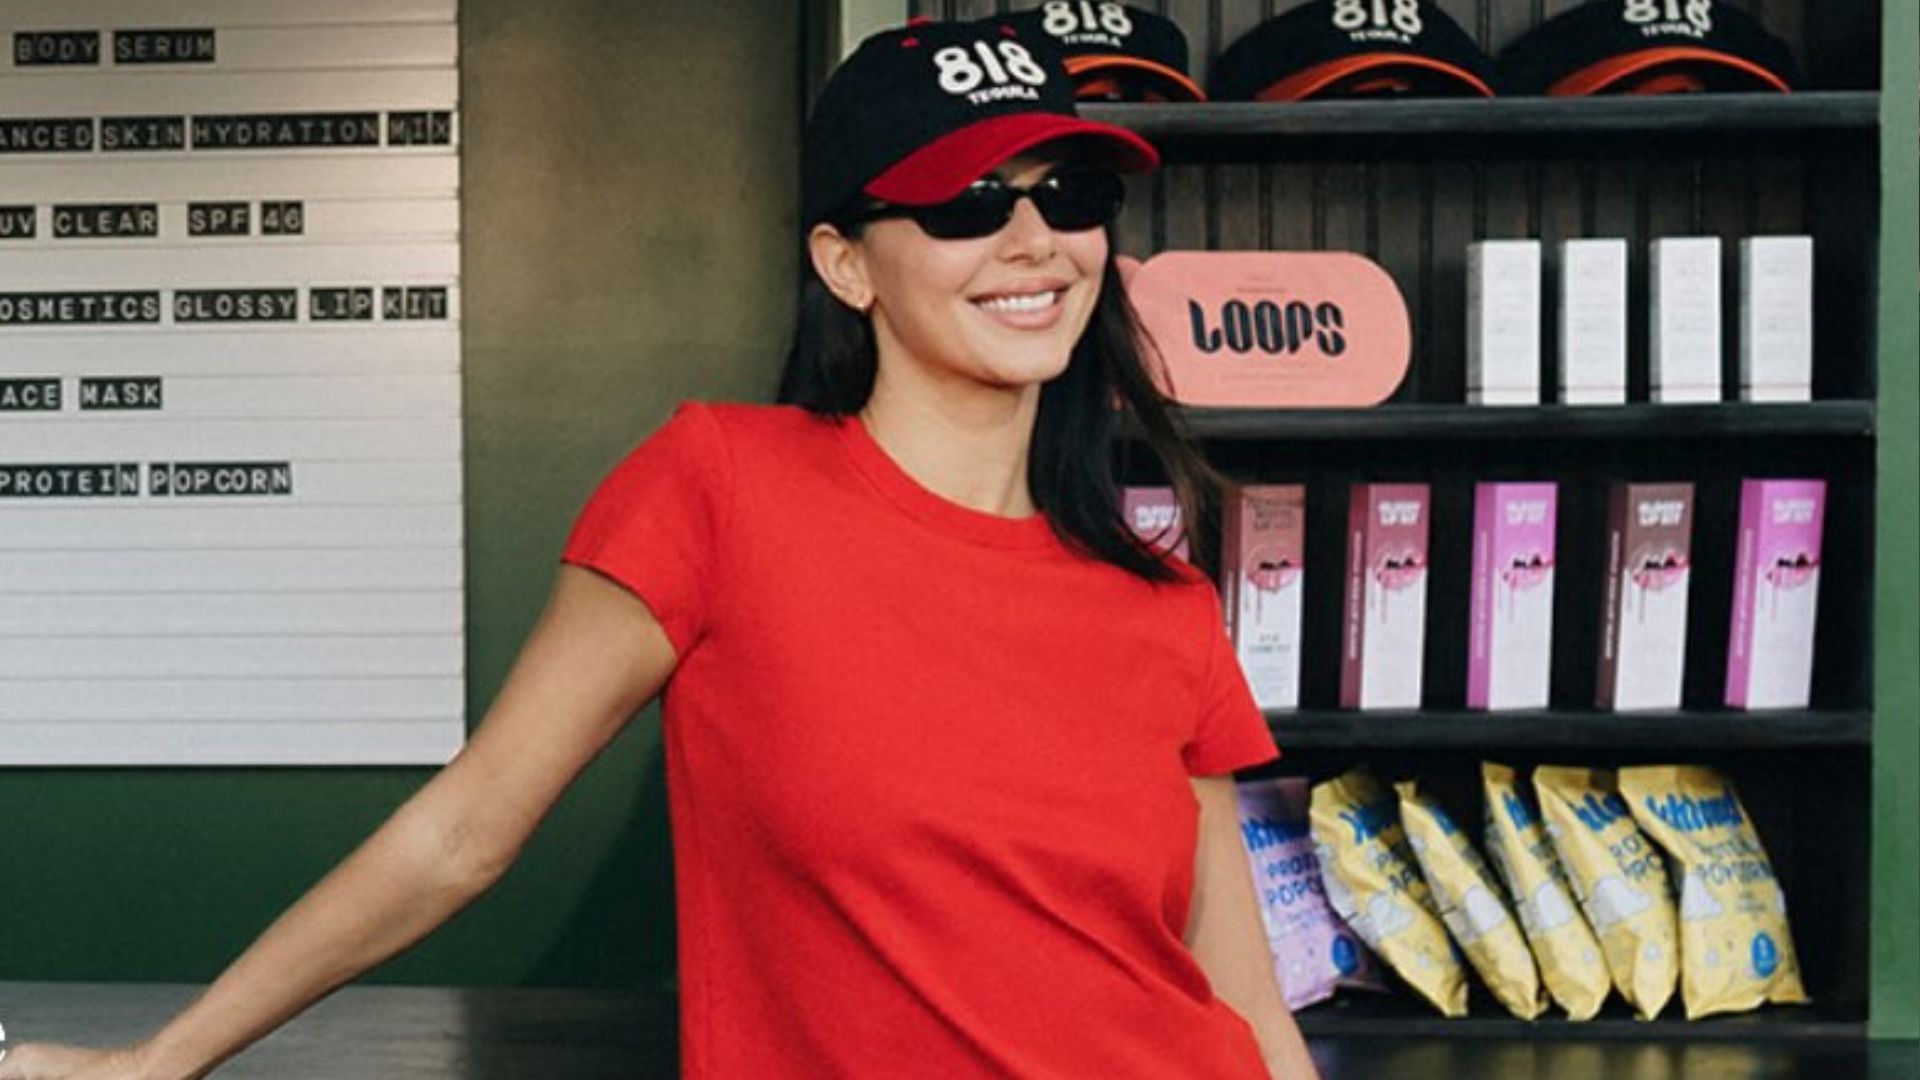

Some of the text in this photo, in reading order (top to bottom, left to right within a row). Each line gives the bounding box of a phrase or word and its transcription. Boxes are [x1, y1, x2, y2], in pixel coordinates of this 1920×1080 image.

[1043, 0, 1134, 36] 818
[1332, 0, 1422, 34] 818
[1623, 0, 1711, 31] 818
[17, 33, 214, 62] BODY SERUM
[933, 40, 1046, 94] 818
[103, 124, 184, 148] SKIN
[193, 119, 379, 144] HYDRATION
[390, 117, 450, 141] MIX
[0, 205, 301, 234] UV CLEAR SPF 46
[0, 292, 447, 321] OSMETICS GLOSSY LIP KIT
[1189, 299, 1347, 357] LOOPS
[1, 383, 161, 408] ACE MASK
[0, 468, 290, 493] PROTEIN POPCORN
